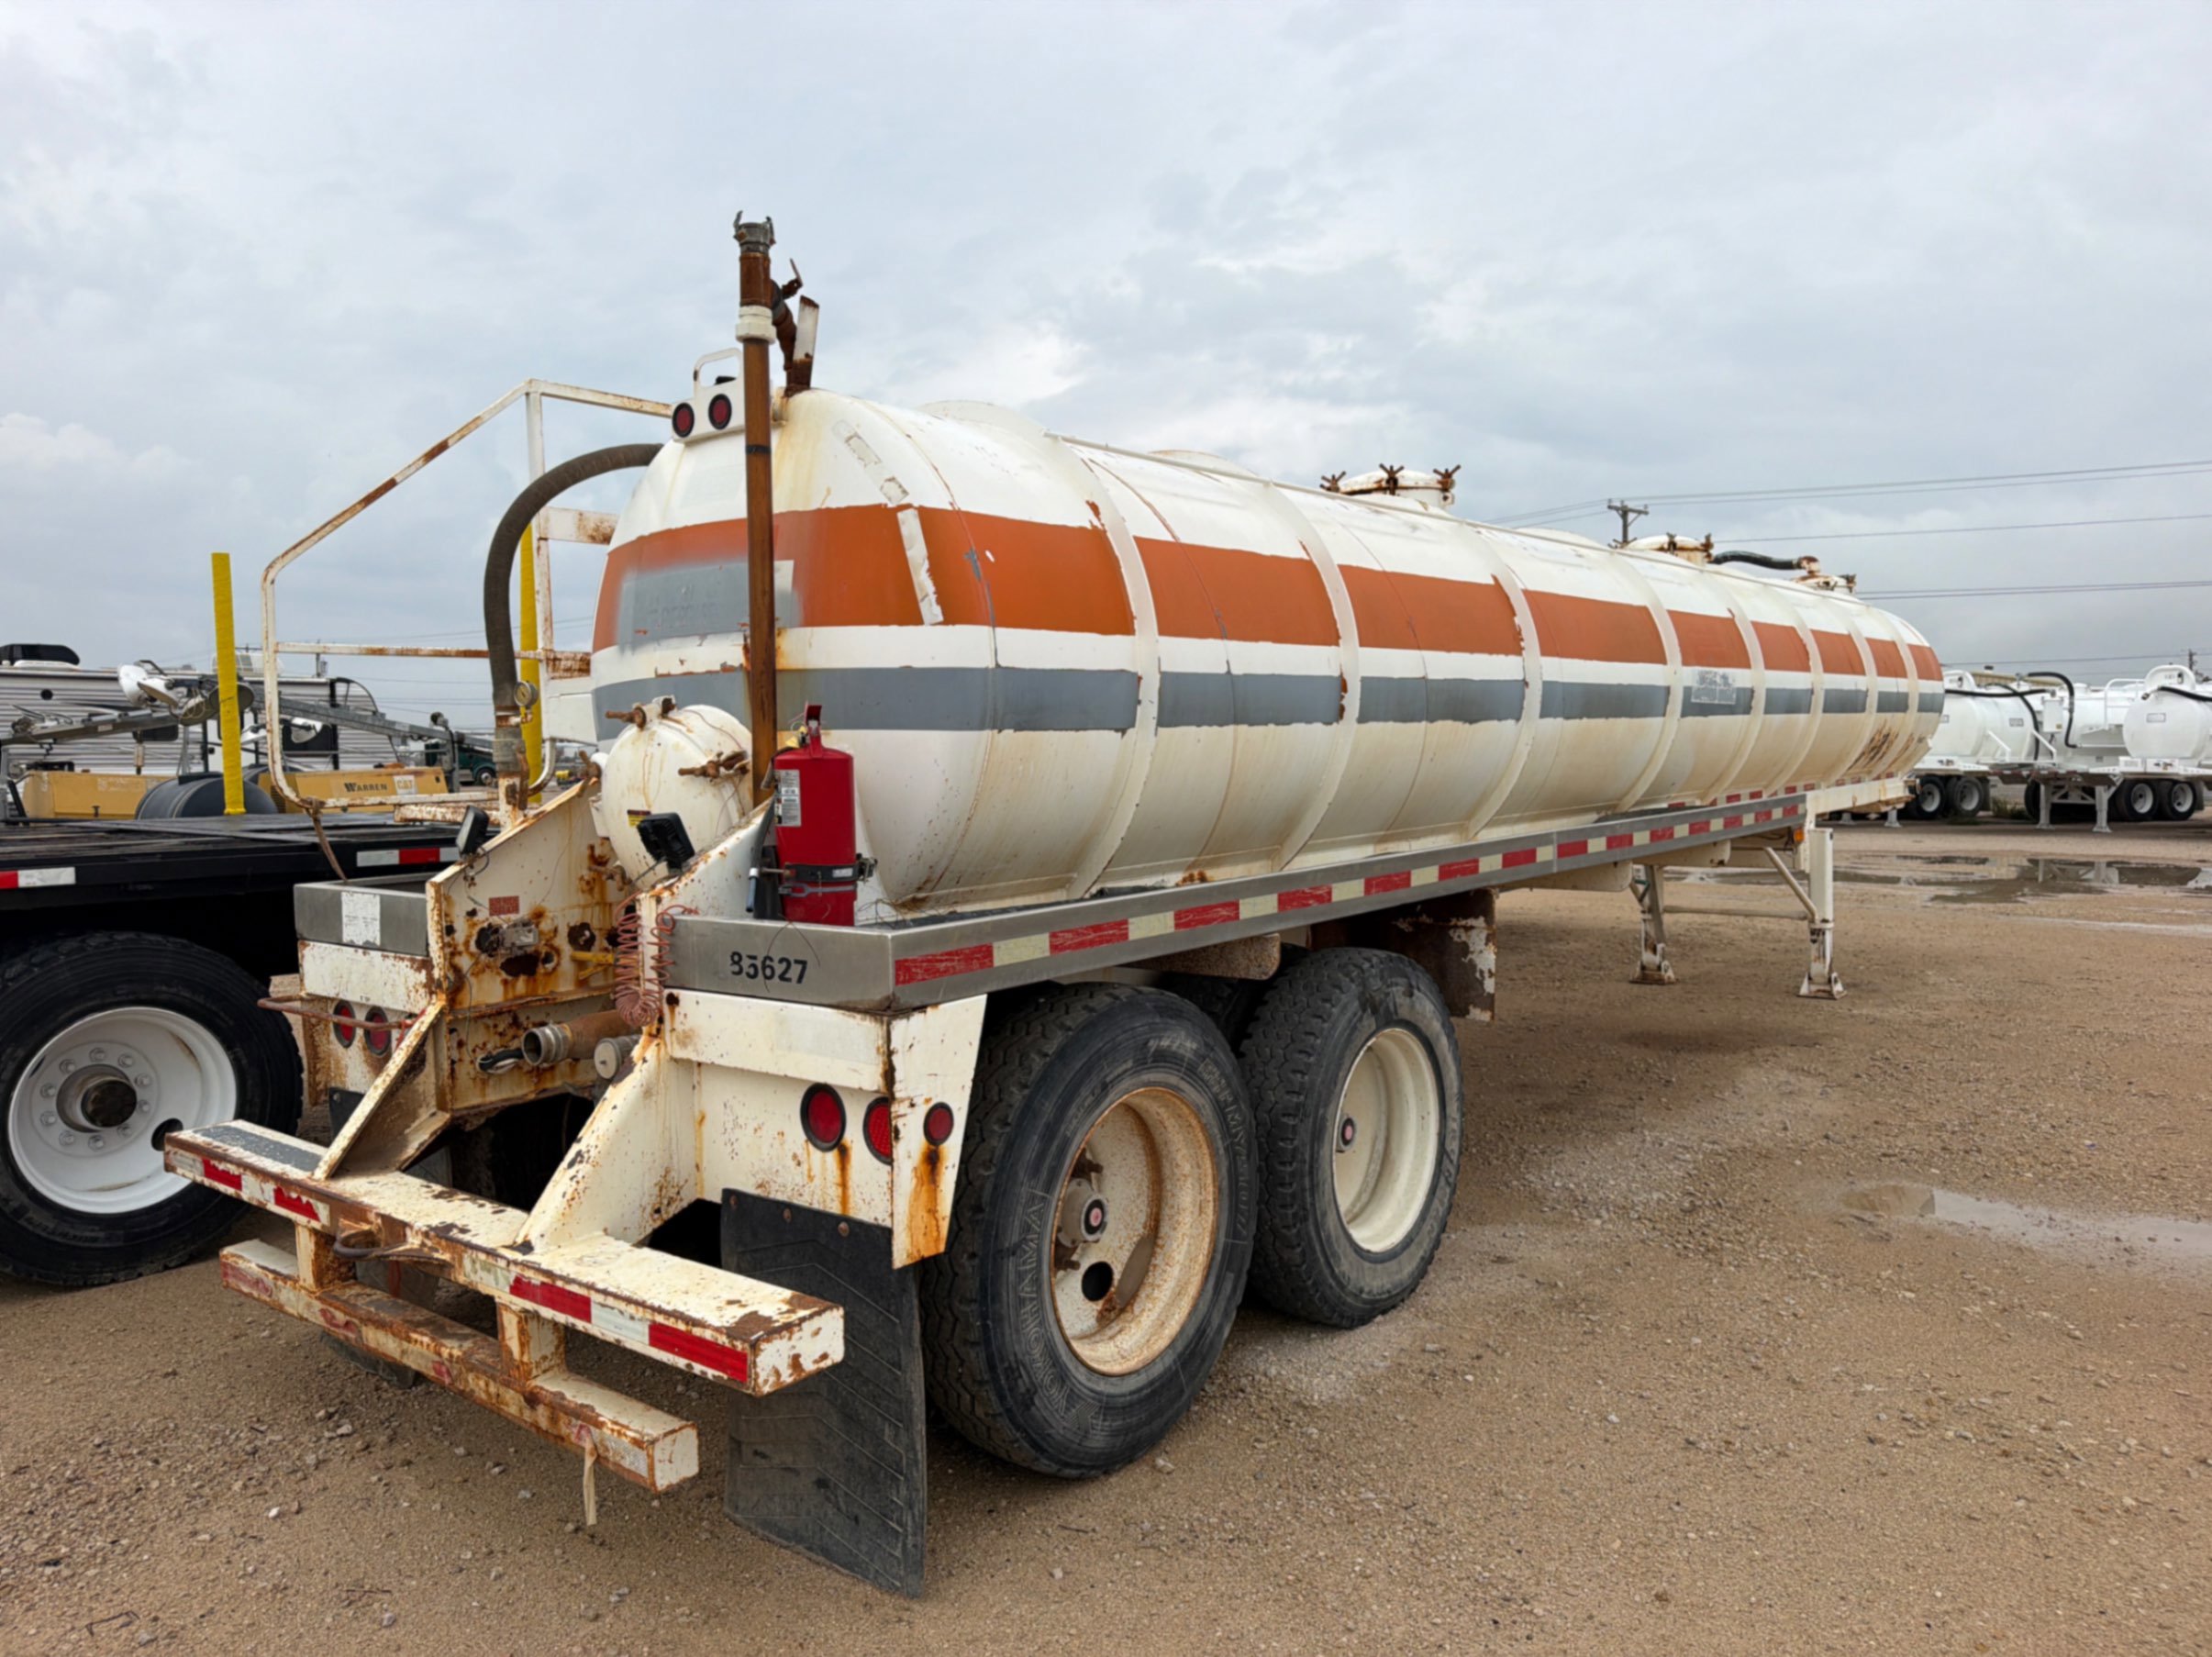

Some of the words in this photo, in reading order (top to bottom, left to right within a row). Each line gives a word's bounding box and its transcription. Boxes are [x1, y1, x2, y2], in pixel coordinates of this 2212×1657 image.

[344, 783, 387, 792] WARREN
[396, 779, 413, 790] CAT
[729, 951, 808, 984] 85627
[1017, 1199, 1073, 1418] YOKOHAMA
